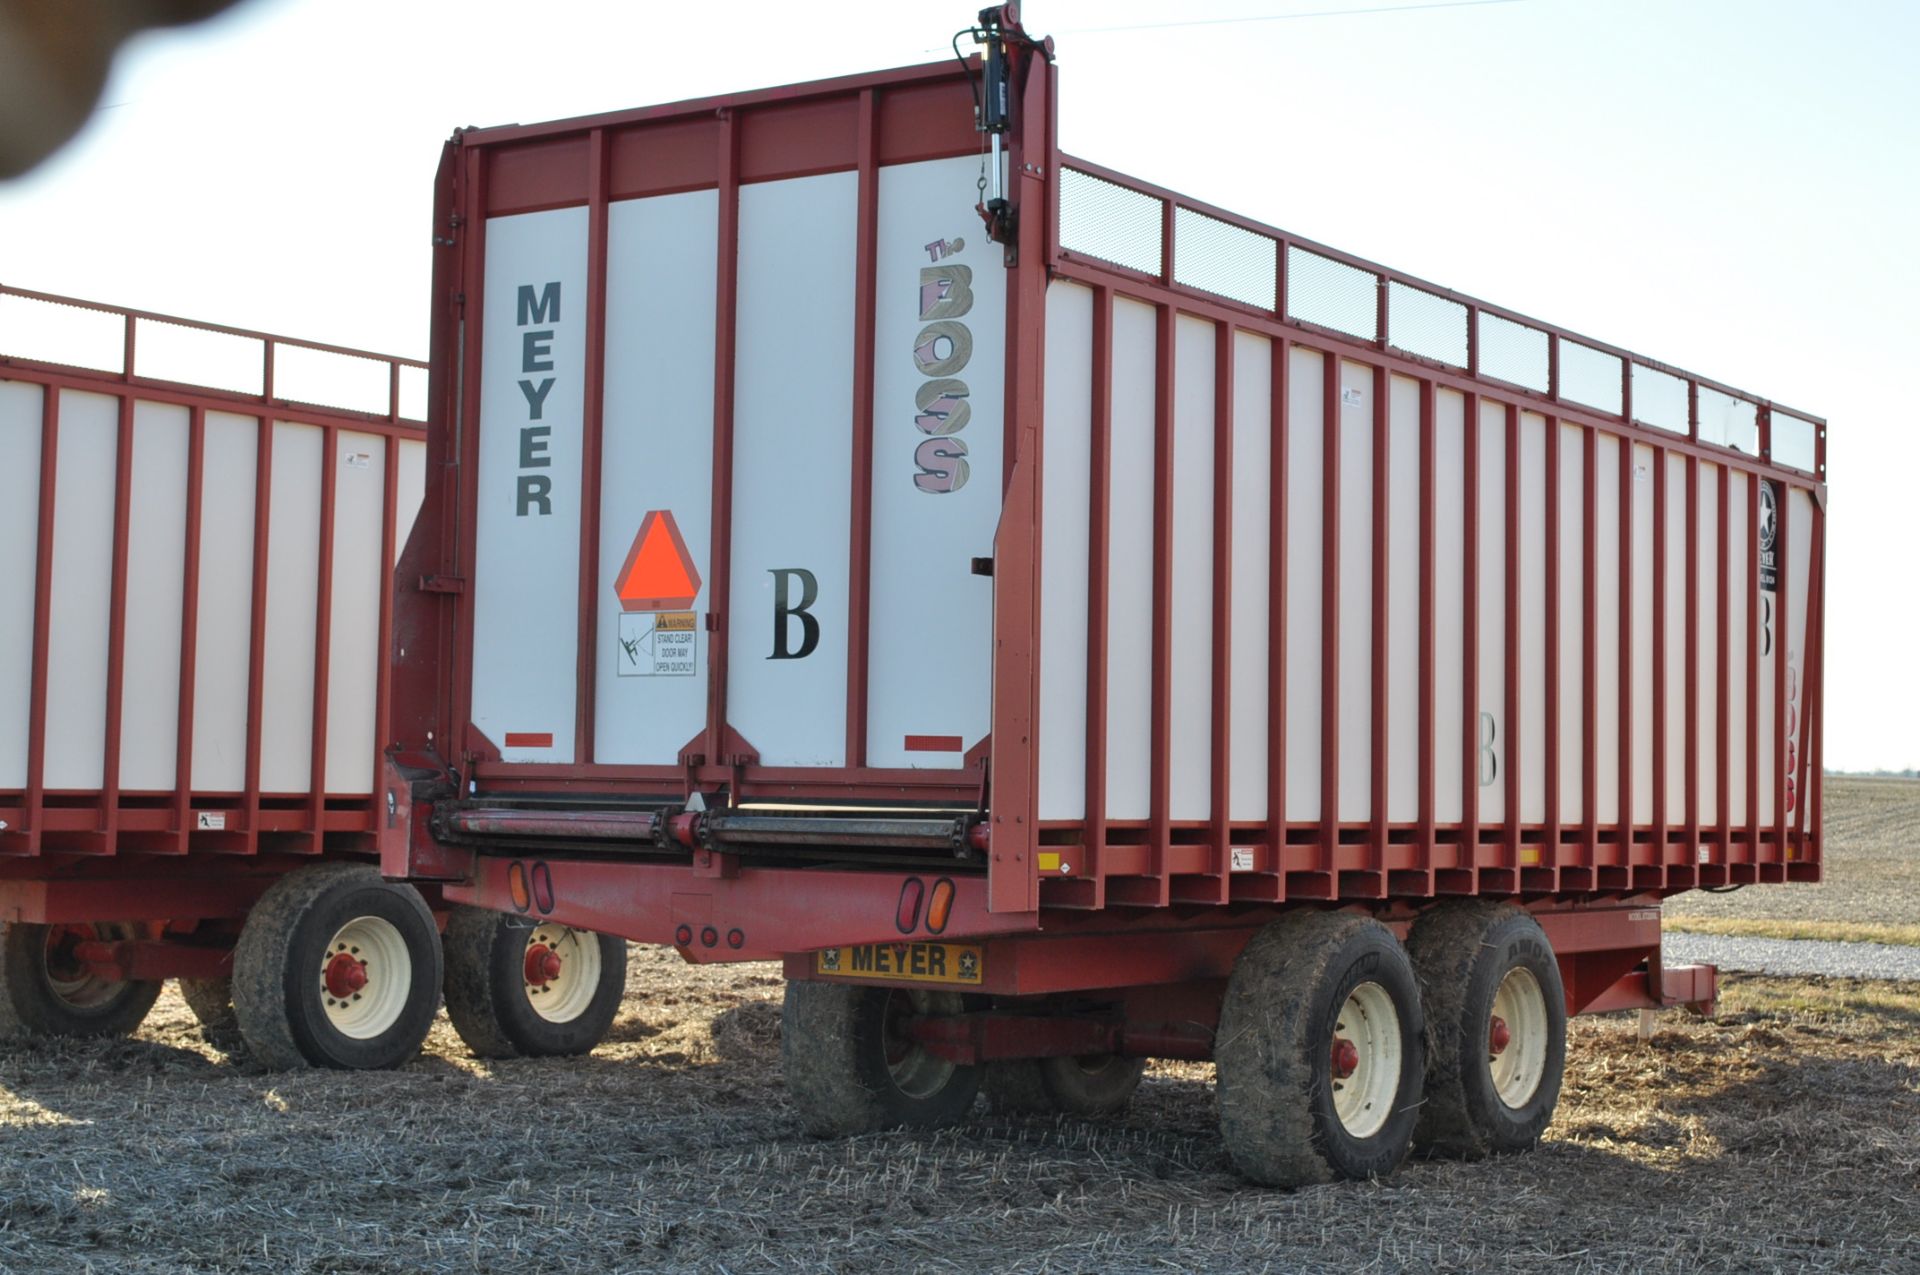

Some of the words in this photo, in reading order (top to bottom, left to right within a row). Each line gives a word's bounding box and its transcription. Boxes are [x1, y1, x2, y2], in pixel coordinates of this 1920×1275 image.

[912, 263, 974, 495] BOSS
[516, 281, 562, 517] MEYER
[667, 618, 695, 629] WARNING
[765, 568, 821, 660] B
[657, 634, 674, 644] STAND
[661, 648, 677, 658] DOOR
[677, 647, 689, 657] MAY
[656, 662, 670, 672] OPEN
[852, 944, 946, 976] MEYER
